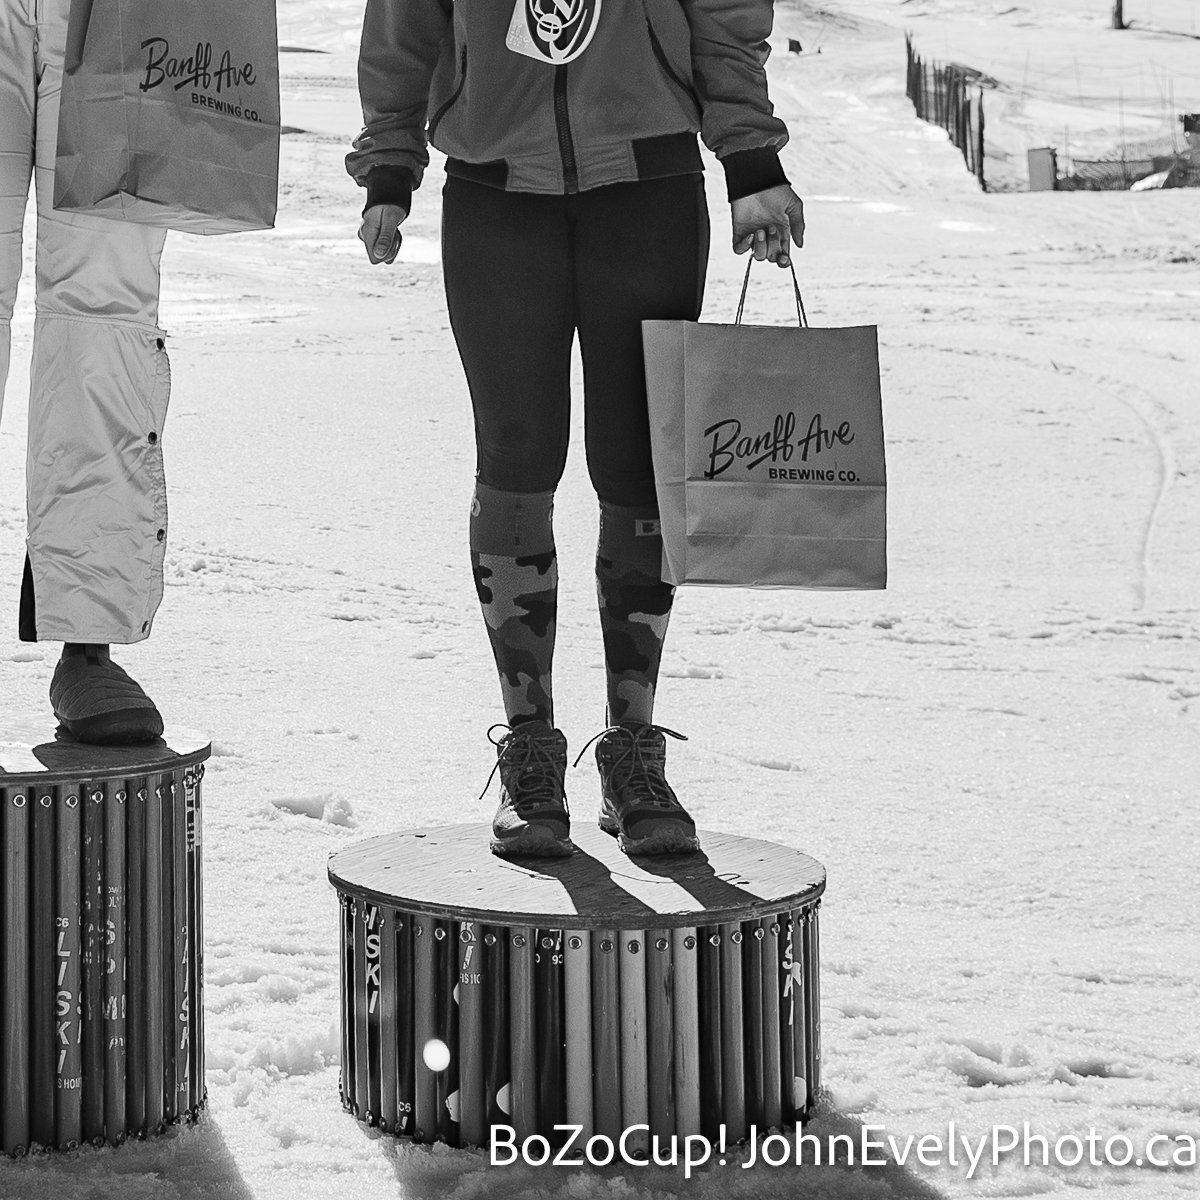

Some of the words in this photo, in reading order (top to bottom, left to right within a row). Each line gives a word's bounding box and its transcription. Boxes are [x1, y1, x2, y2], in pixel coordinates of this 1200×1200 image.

[139, 37, 212, 93] Banff
[213, 50, 257, 93] Ave
[191, 93, 242, 117] BREWING
[244, 107, 262, 123] CO.
[703, 411, 796, 480] Banff
[797, 413, 855, 462] Ave
[768, 467, 834, 481] BREWING
[837, 469, 860, 483] CO.
[56, 931, 71, 1074] LISKI
